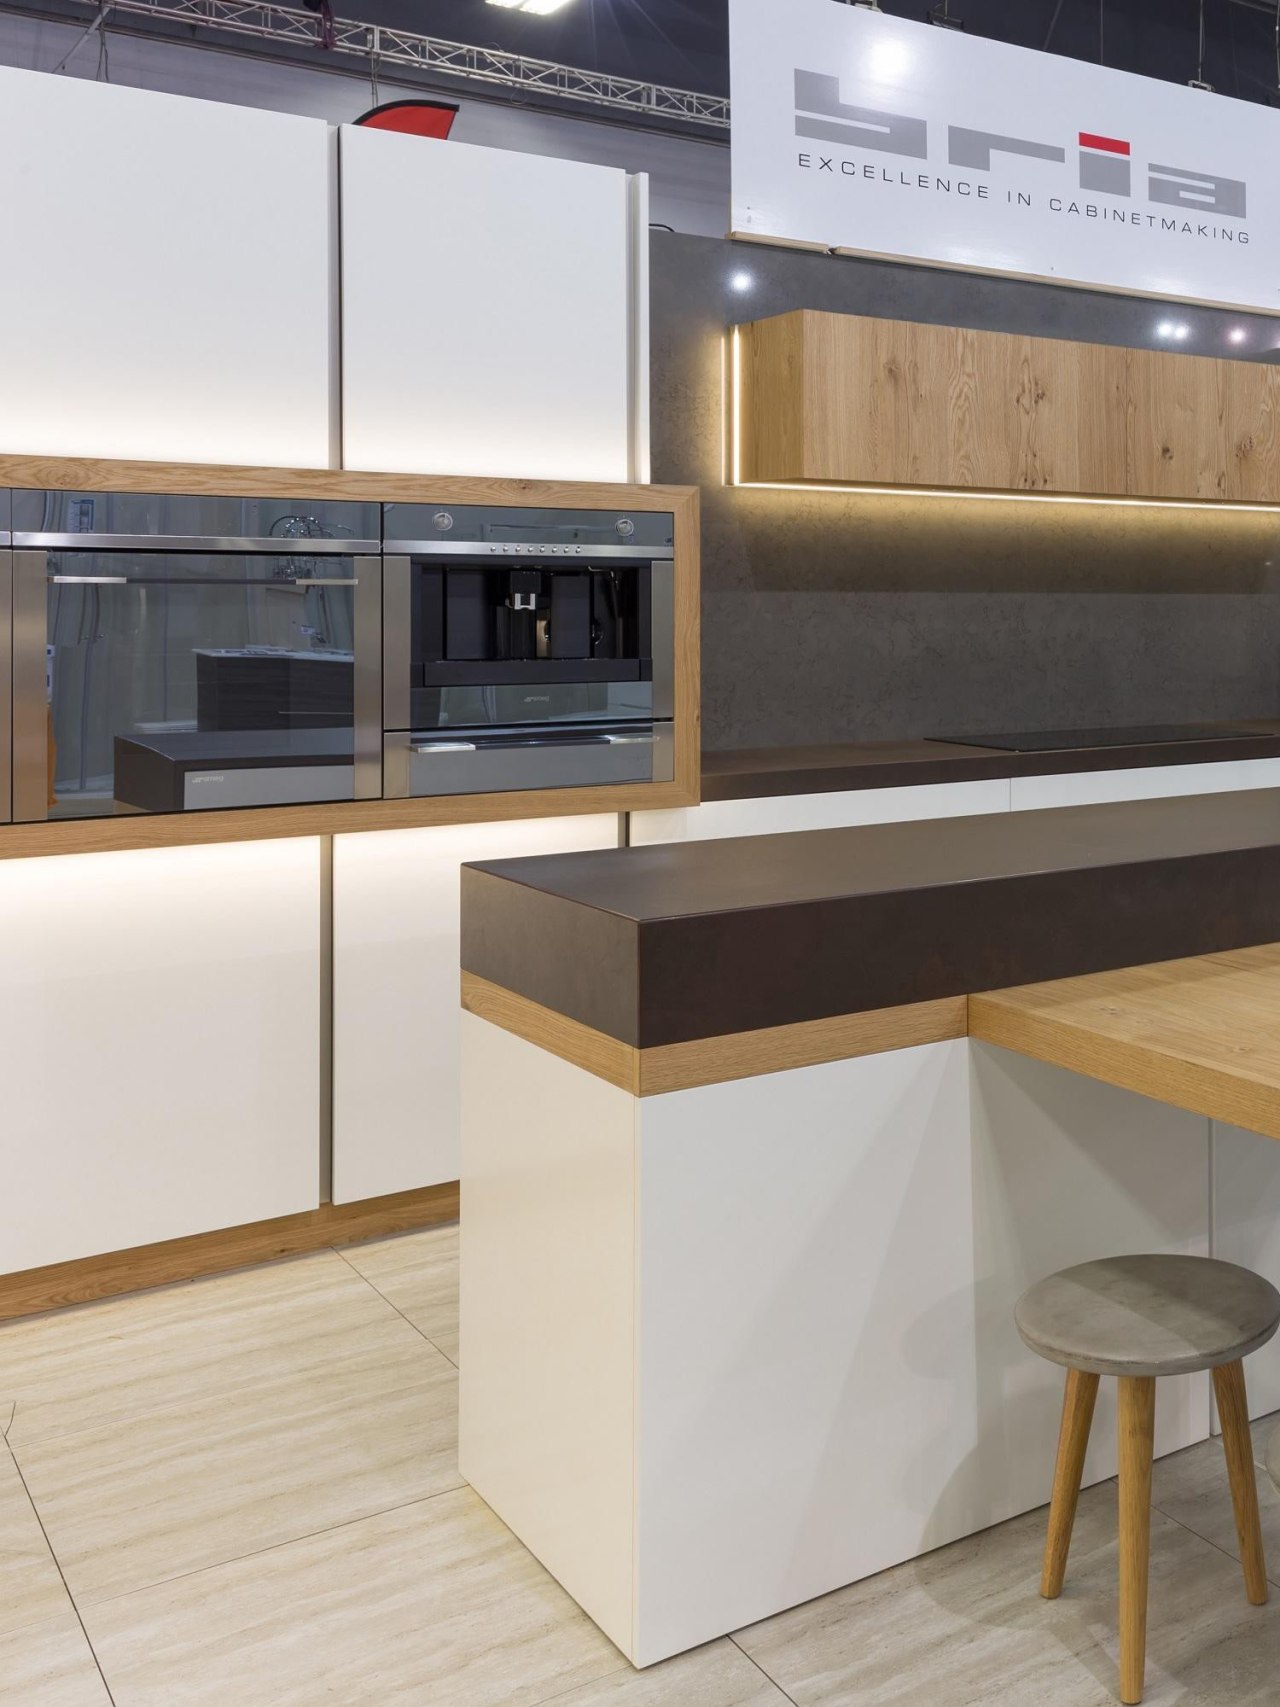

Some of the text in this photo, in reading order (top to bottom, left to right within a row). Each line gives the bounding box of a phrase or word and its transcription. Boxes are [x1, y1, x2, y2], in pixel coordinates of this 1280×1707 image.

[794, 67, 1247, 219] bria
[798, 153, 1250, 244] EXCELLENCE IN CABINETMAKING
